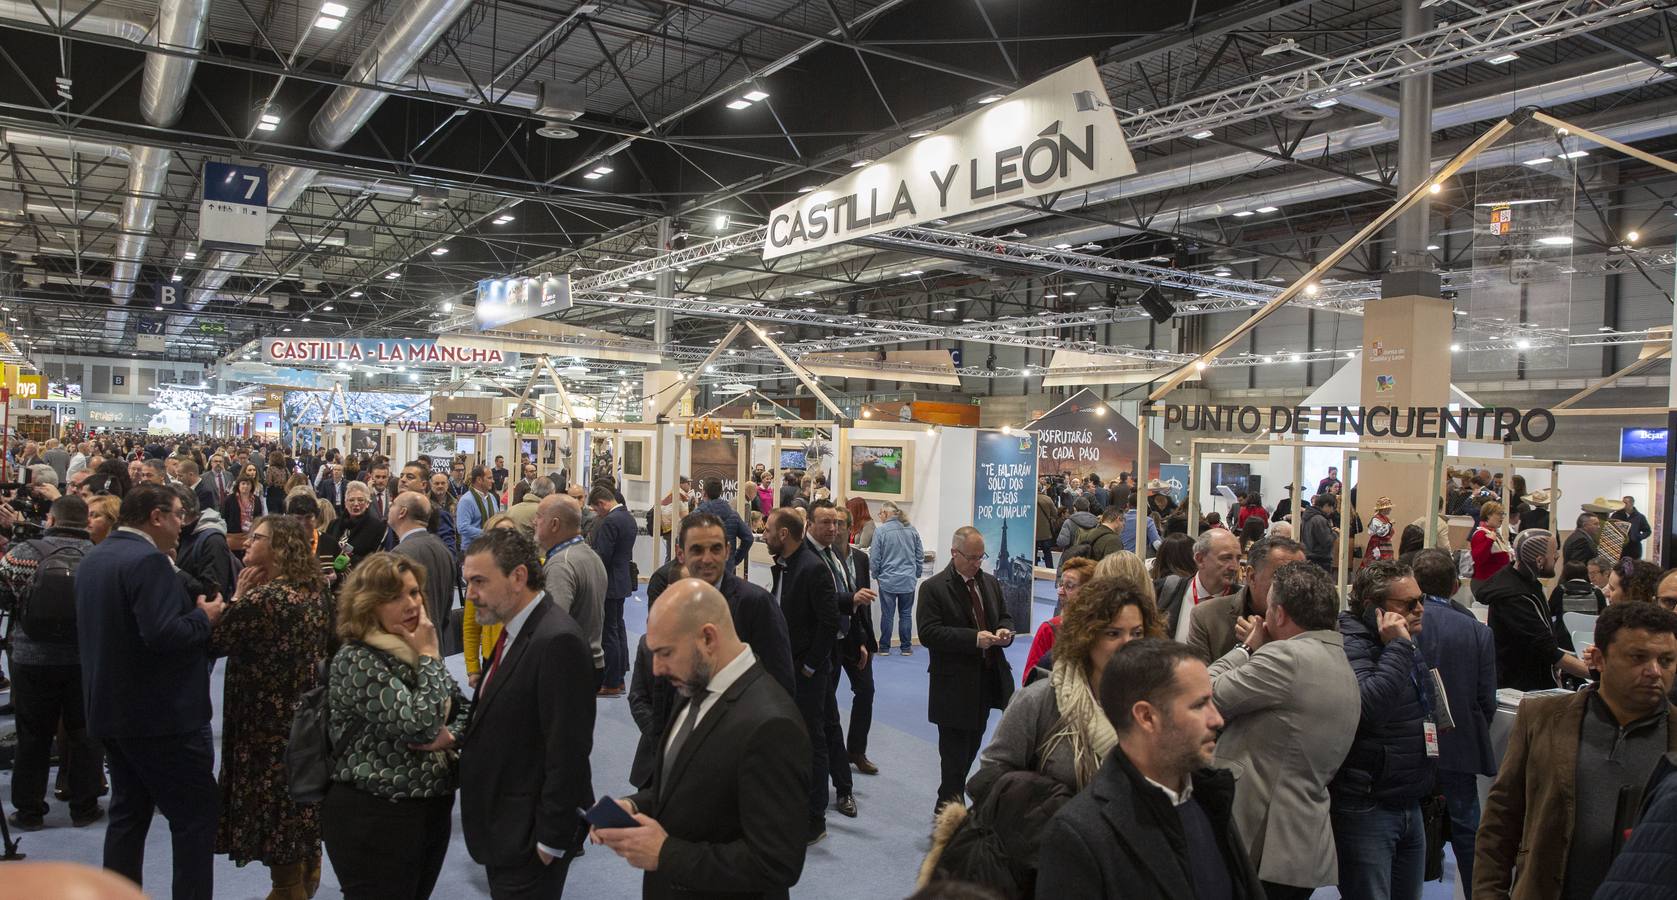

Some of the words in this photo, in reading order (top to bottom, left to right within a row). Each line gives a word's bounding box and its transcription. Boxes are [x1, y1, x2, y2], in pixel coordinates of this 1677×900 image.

[243, 174, 260, 200] 7
[769, 178, 917, 249] CASTILLA
[930, 164, 959, 208] Y
[970, 119, 1095, 200] LEÓN
[161, 285, 176, 305] B
[154, 322, 162, 334] 7
[269, 340, 364, 361] CASTILLA
[377, 342, 406, 361] LA
[407, 343, 504, 364] MANCHA
[951, 350, 960, 365] C
[115, 376, 122, 385] B
[398, 420, 487, 434] VALLADOLID
[686, 415, 722, 441] LEÓN
[1163, 404, 1261, 435] PUNTO
[1269, 405, 1312, 435] DE
[1319, 405, 1556, 443] ENCUENTRO
[1052, 446, 1076, 460] CADA
[1079, 447, 1100, 461] PASO
[998, 461, 1032, 477] FALTARÁN
[987, 475, 1006, 491] SÓLO
[1009, 477, 1024, 491] DOS
[992, 491, 1018, 505] DESEOS
[978, 505, 993, 520] POR
